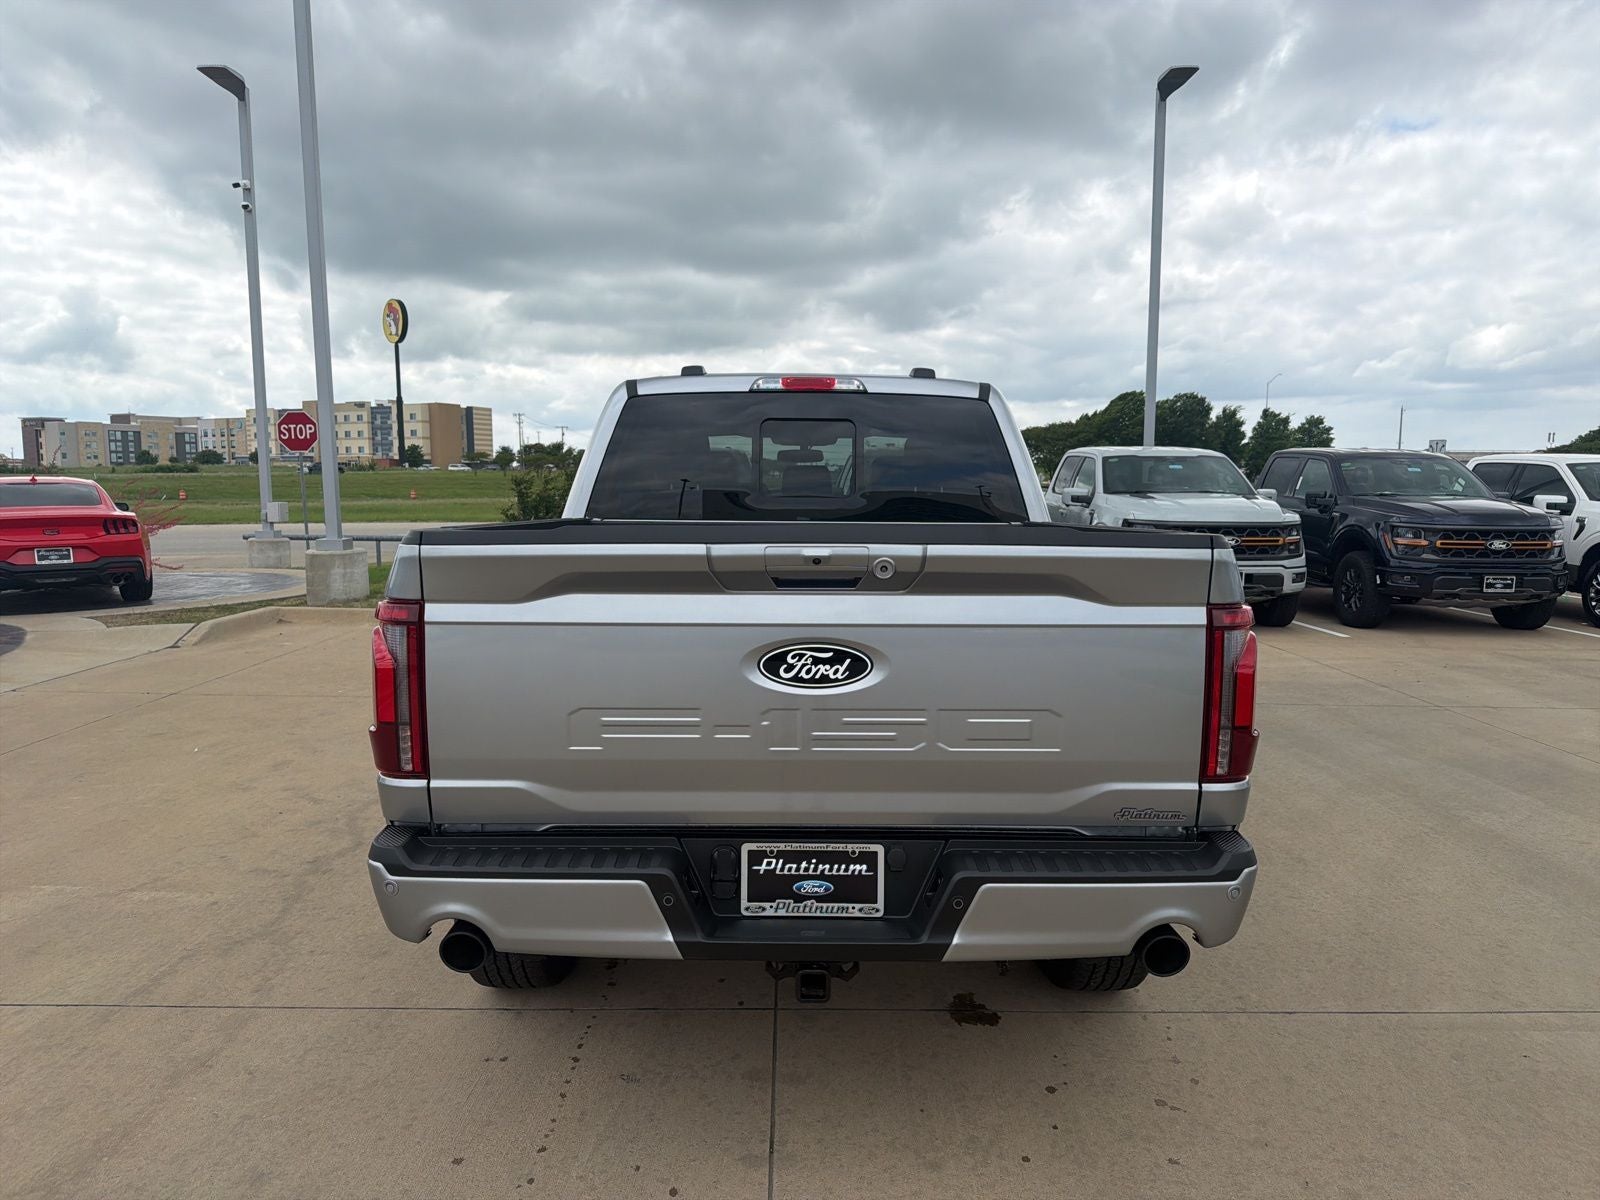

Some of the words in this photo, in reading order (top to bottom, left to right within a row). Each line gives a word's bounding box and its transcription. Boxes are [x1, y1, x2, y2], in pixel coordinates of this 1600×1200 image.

[280, 424, 315, 439] STOP
[779, 650, 851, 679] Ford
[567, 707, 1063, 752] F-150
[1115, 807, 1187, 821] Platinum
[752, 858, 874, 875] Platinum
[800, 881, 826, 893] Ford
[774, 900, 856, 914] Platinum
